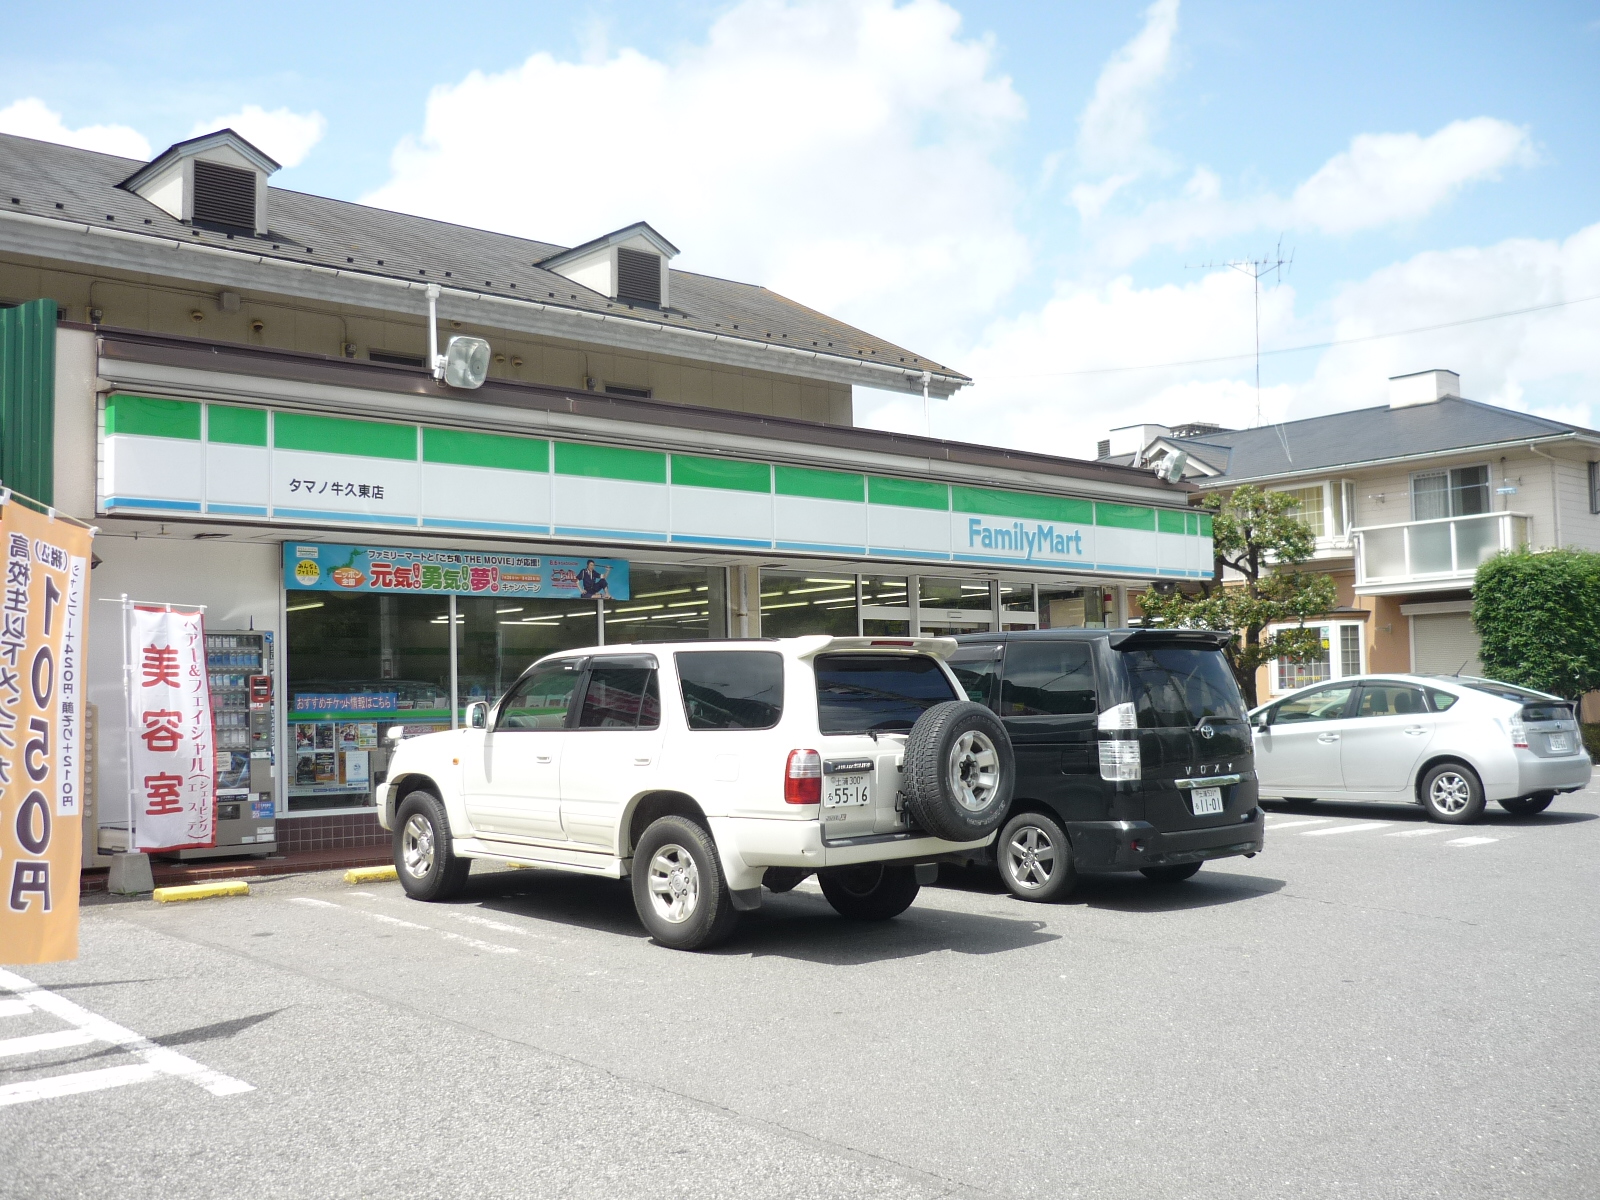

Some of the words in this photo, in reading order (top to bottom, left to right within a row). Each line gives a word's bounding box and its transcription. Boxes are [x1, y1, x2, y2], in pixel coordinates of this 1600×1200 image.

[289, 478, 384, 499] タマノ牛久東店
[968, 518, 1082, 561] FamilyMart
[464, 555, 482, 564] THE
[141, 643, 184, 815] 美容室
[1185, 763, 1232, 775] VOXY
[834, 786, 868, 804] 55-16
